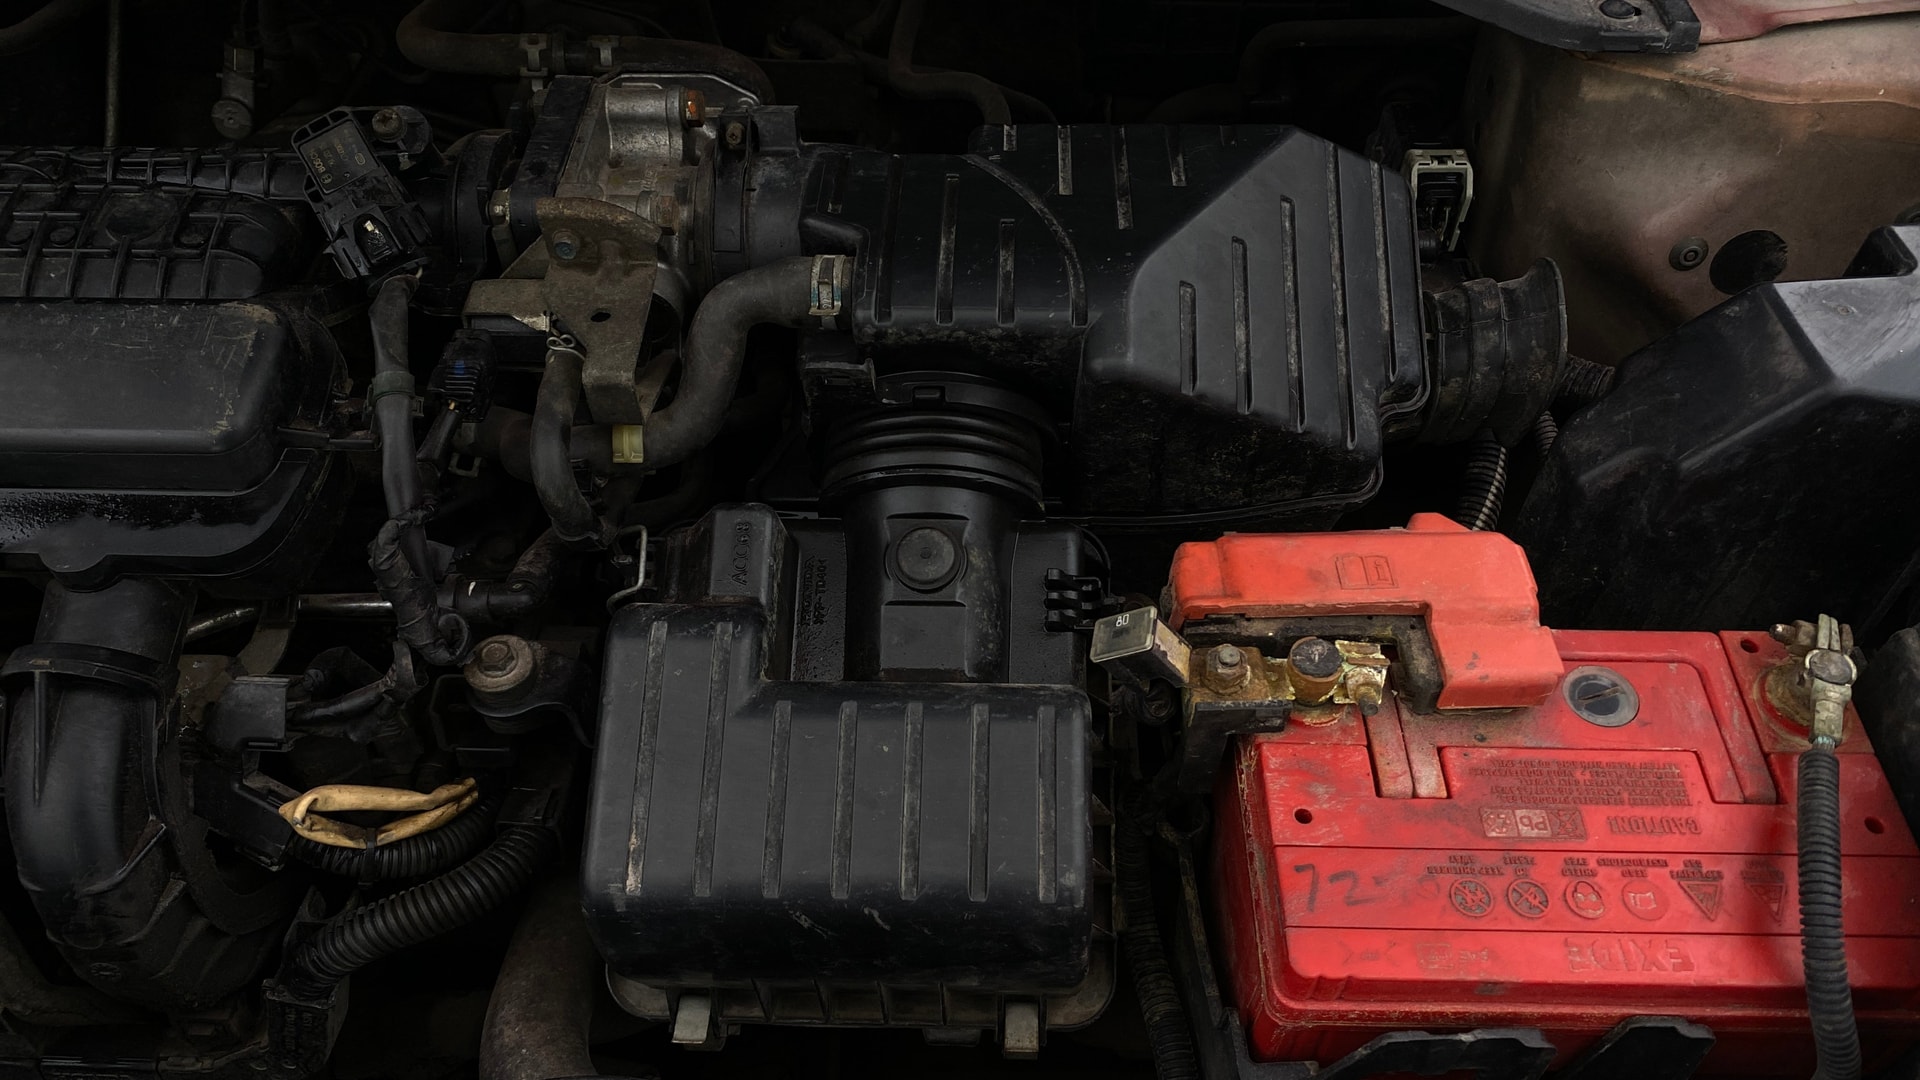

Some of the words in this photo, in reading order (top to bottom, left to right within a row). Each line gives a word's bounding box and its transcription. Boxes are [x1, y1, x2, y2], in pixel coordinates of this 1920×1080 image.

[801, 555, 815, 626] HONDA
[1115, 613, 1129, 626] 80
[1518, 814, 1548, 832] Pb
[1607, 814, 1701, 836] CAUTION!
[1565, 938, 1695, 973] EXIDE
